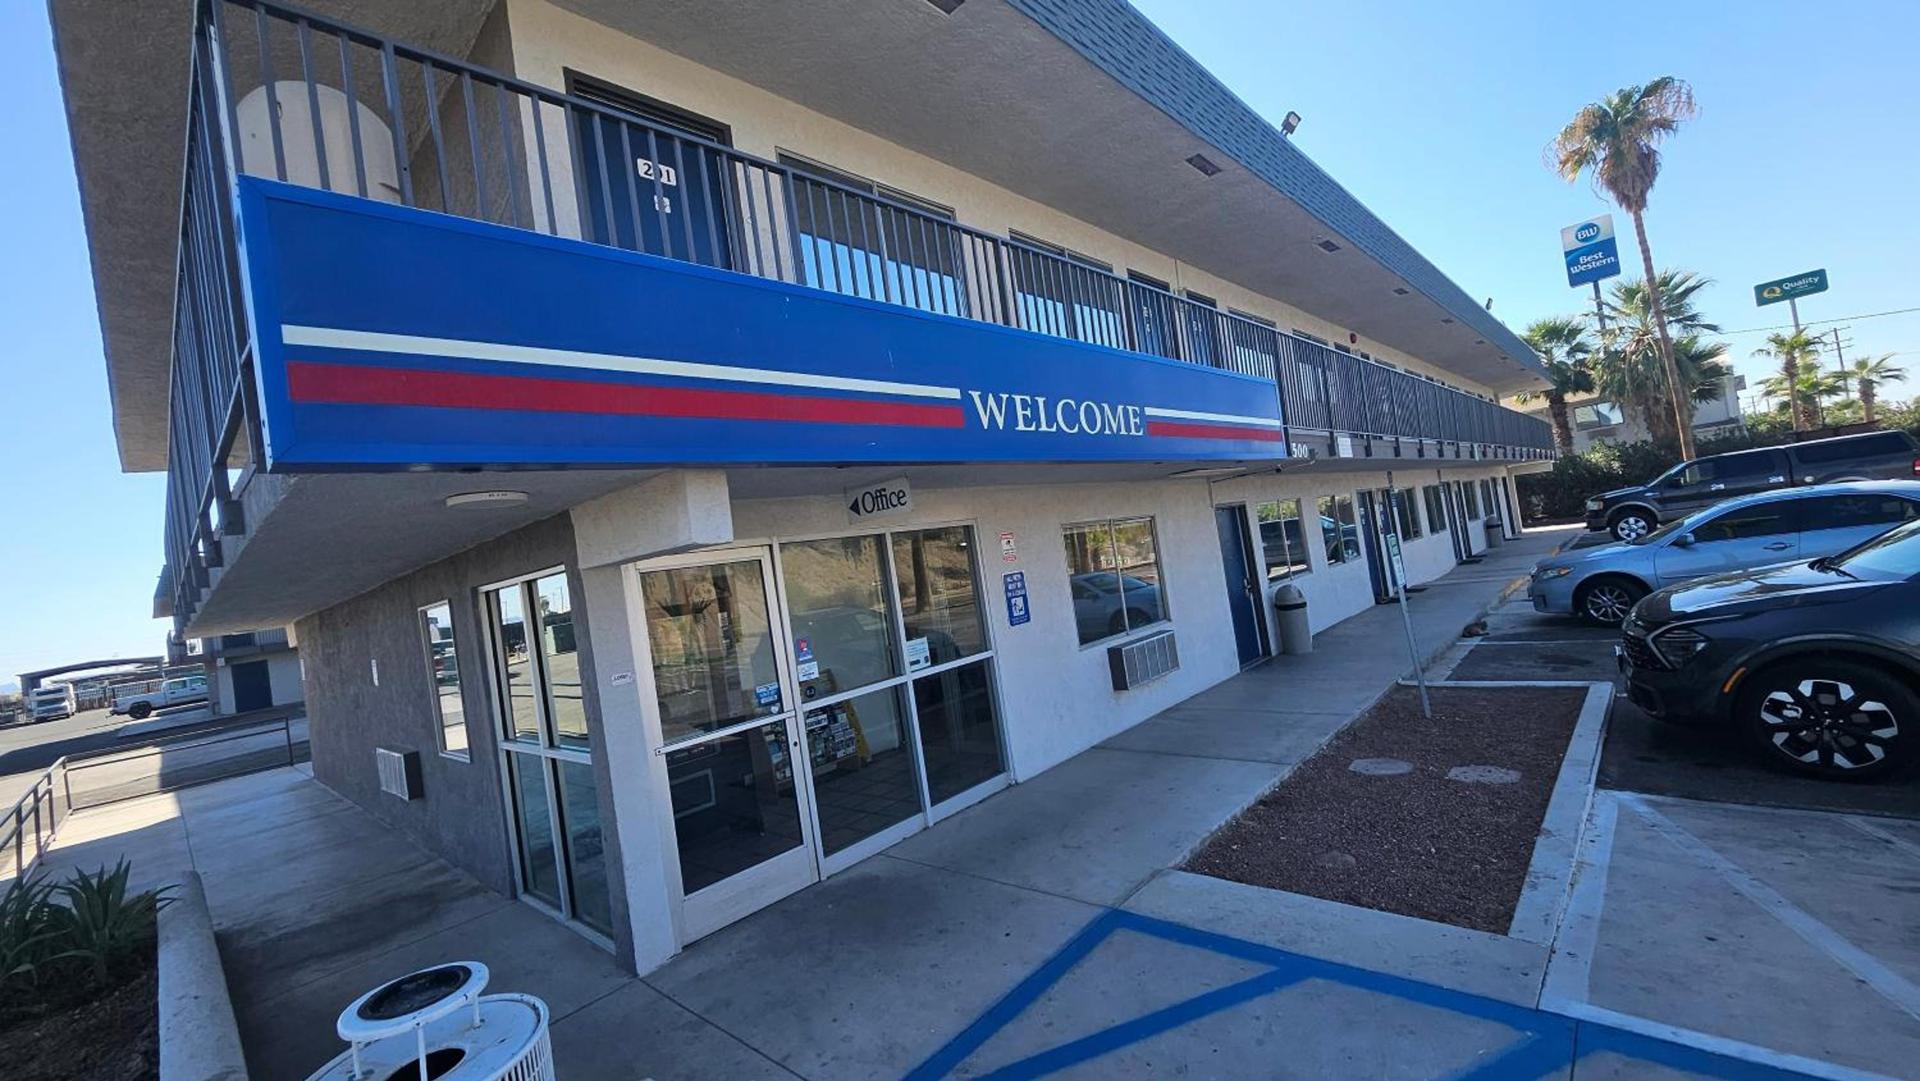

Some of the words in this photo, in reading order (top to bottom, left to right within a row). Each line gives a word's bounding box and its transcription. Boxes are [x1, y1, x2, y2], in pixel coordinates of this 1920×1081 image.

[643, 162, 672, 183] 21
[1577, 226, 1597, 240] BW
[1570, 256, 1615, 274] Western
[1579, 251, 1605, 264] Best
[1782, 276, 1820, 291] Quality
[968, 390, 1144, 436] WELCOME
[861, 487, 907, 514] Office
